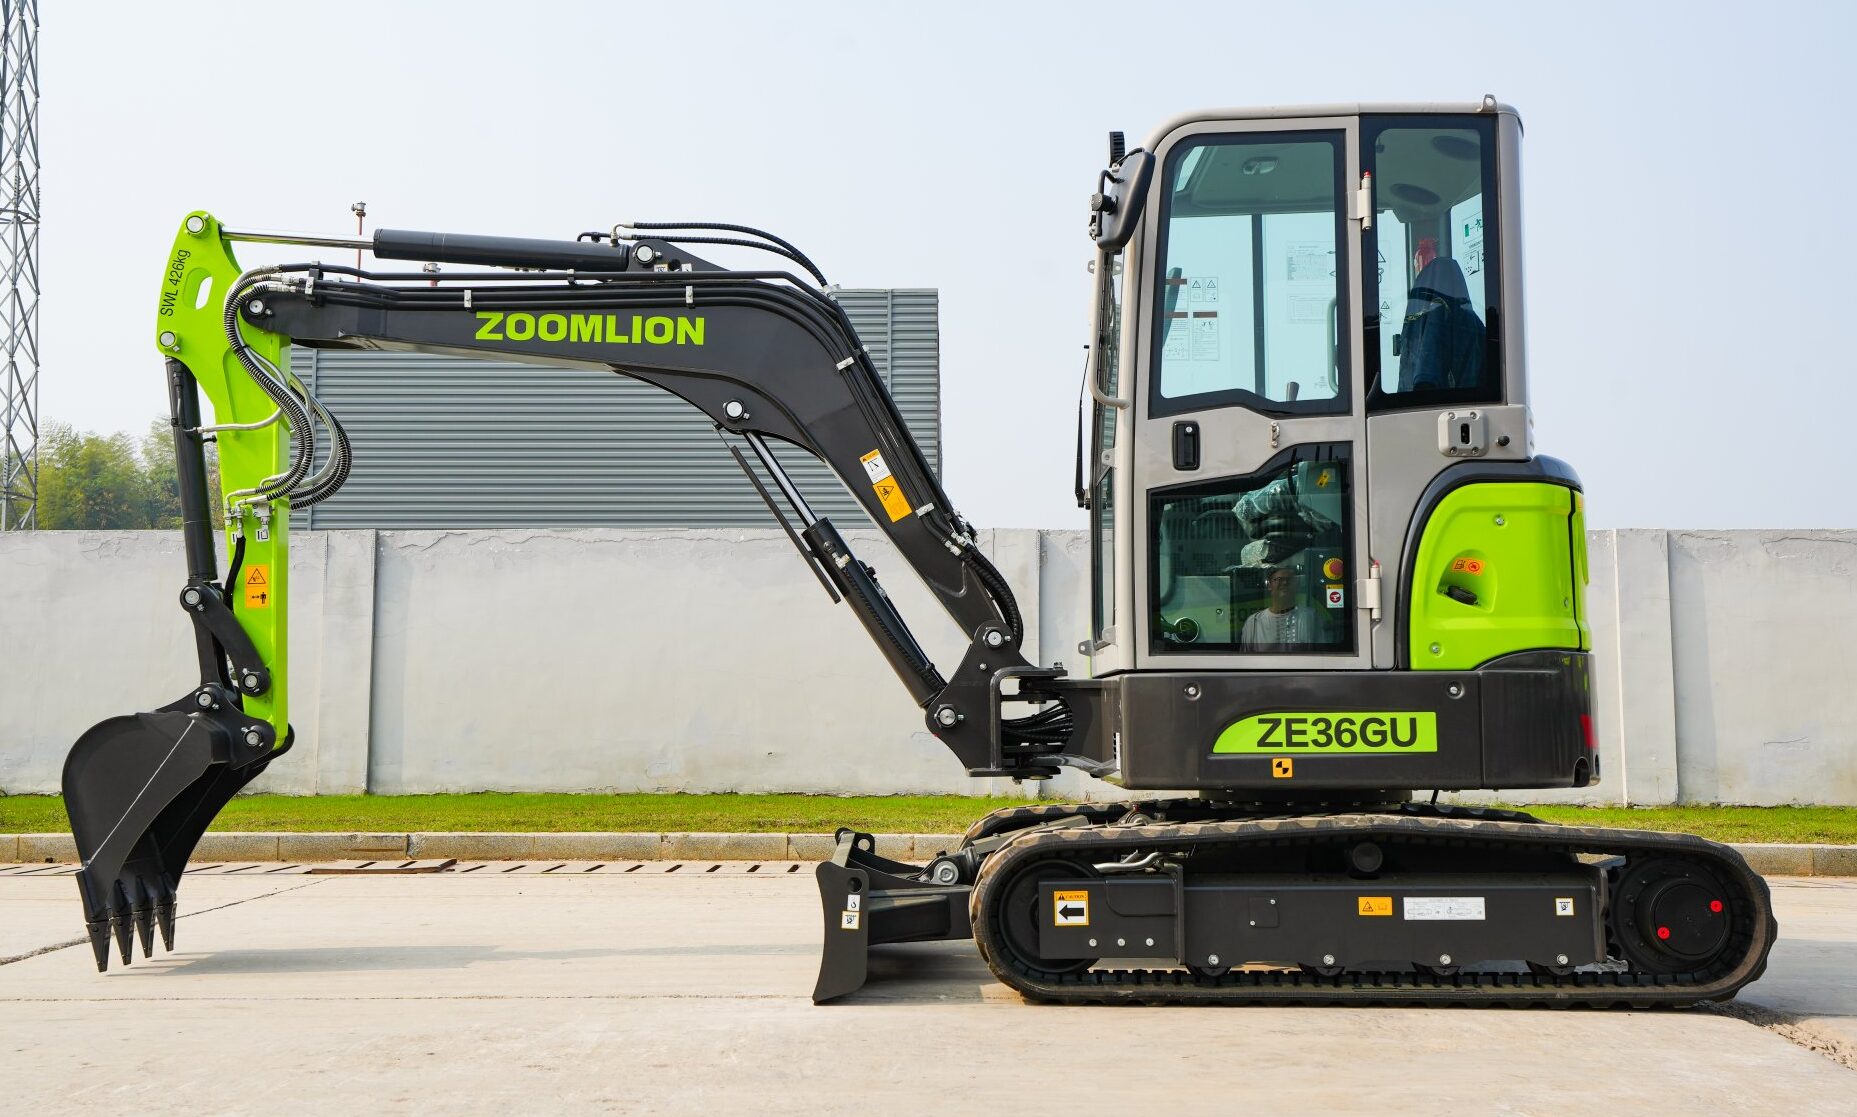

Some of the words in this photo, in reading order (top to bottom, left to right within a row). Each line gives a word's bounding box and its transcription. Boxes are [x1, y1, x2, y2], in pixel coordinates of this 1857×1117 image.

[168, 249, 191, 286] 426kg
[160, 289, 178, 317] SWL
[475, 312, 705, 345] ZOOMLION
[1257, 717, 1418, 748] ZE36GU
